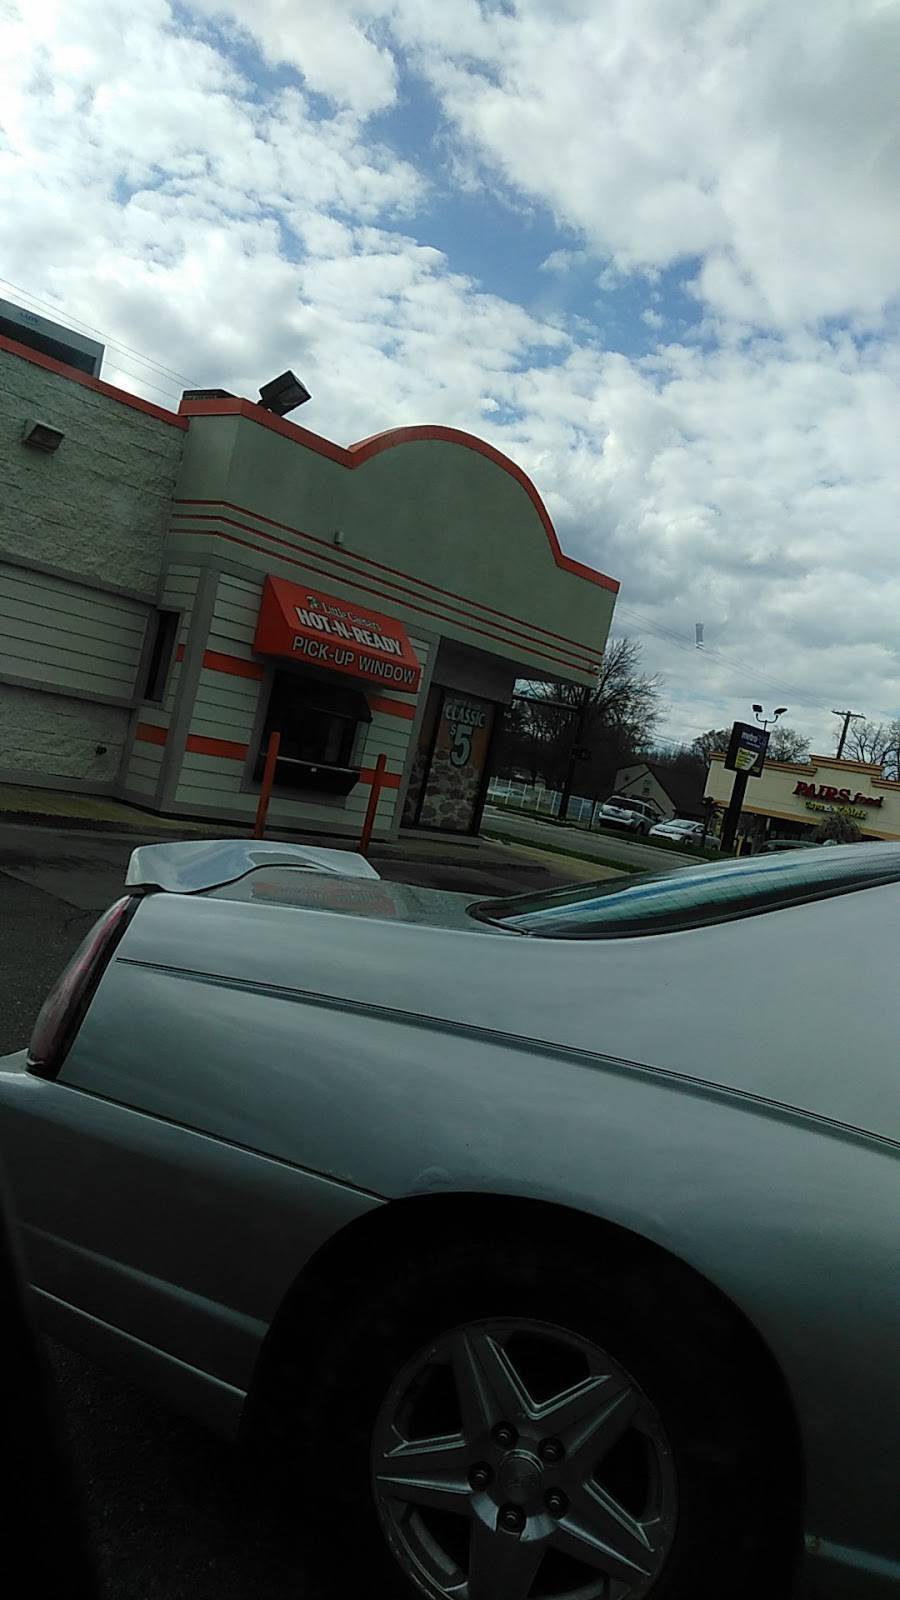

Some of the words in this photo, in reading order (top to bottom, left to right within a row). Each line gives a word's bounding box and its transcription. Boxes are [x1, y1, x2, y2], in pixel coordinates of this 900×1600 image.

[295, 606, 404, 657] HOT-N-READY
[292, 635, 355, 667] PICK-UP
[358, 654, 416, 685] WINDOW
[444, 703, 487, 728] CLASSIC
